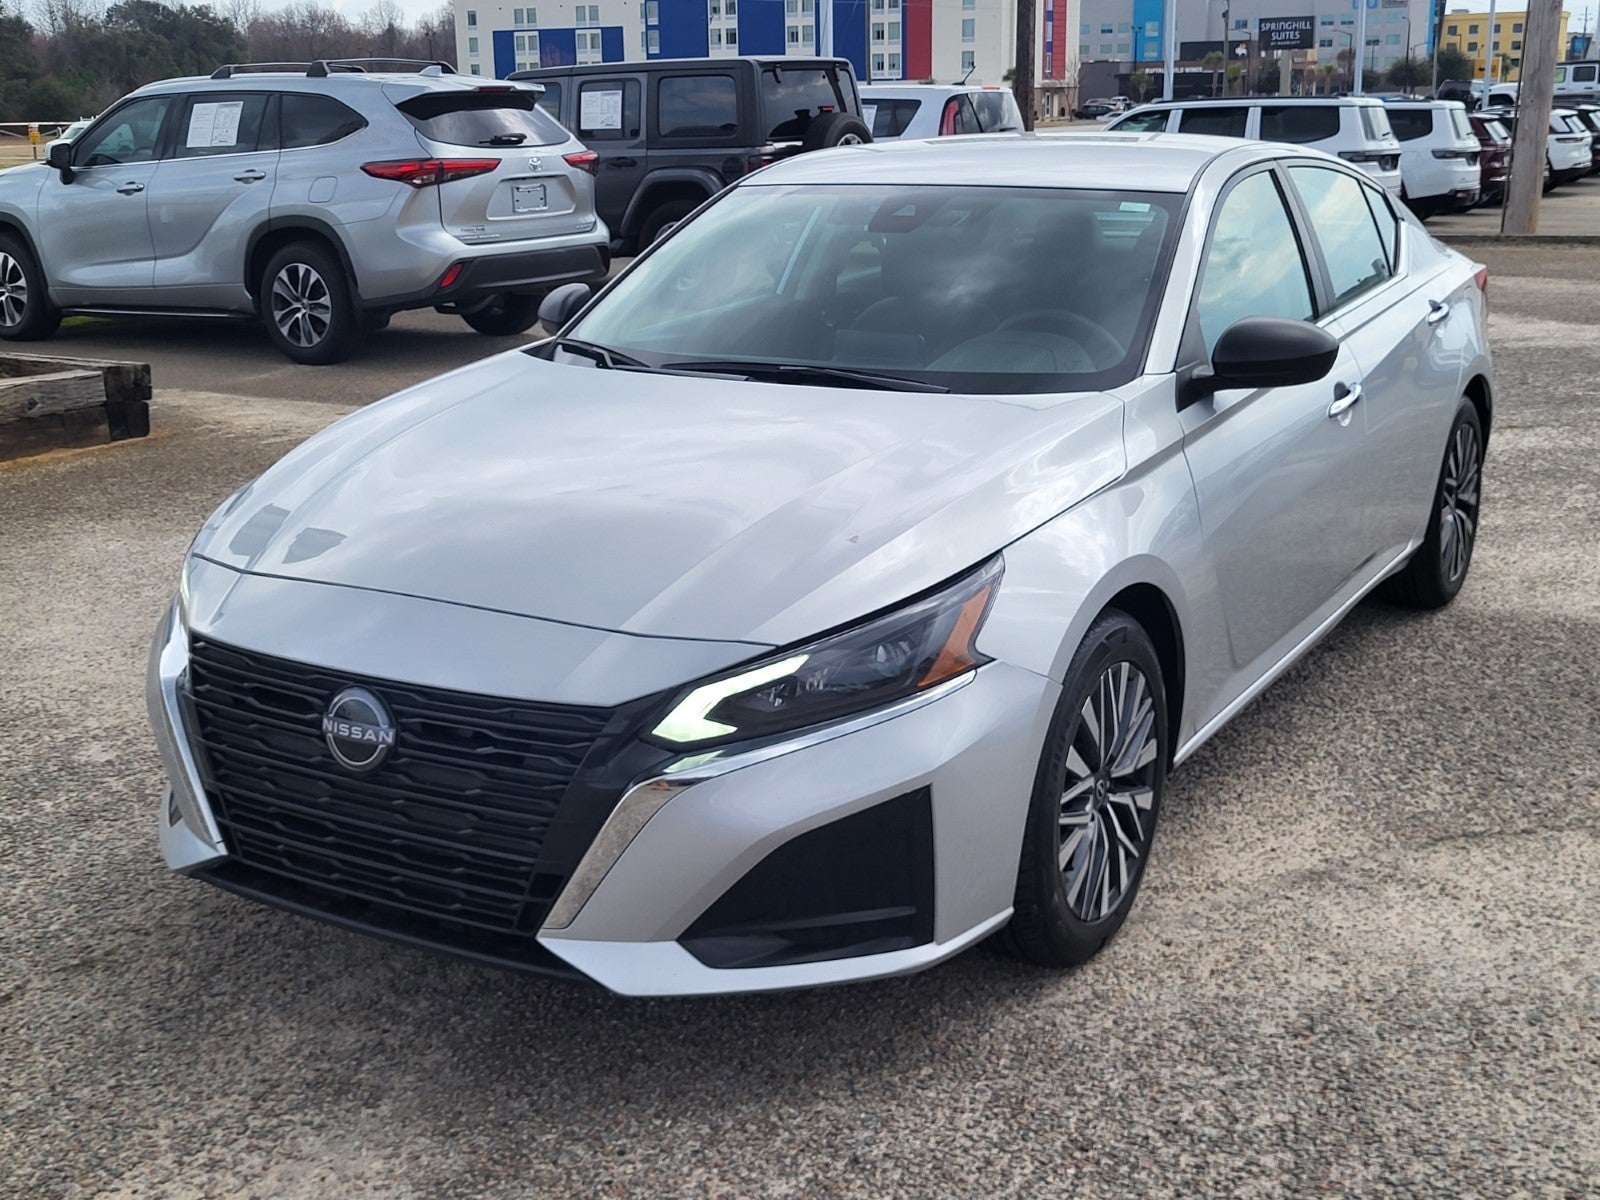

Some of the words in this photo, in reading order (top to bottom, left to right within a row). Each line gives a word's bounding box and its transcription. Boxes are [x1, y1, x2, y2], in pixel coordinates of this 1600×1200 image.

[1261, 21, 1312, 31] SPRINGHILL
[1271, 31, 1300, 41] SUITES
[323, 717, 393, 743] NISSAN
